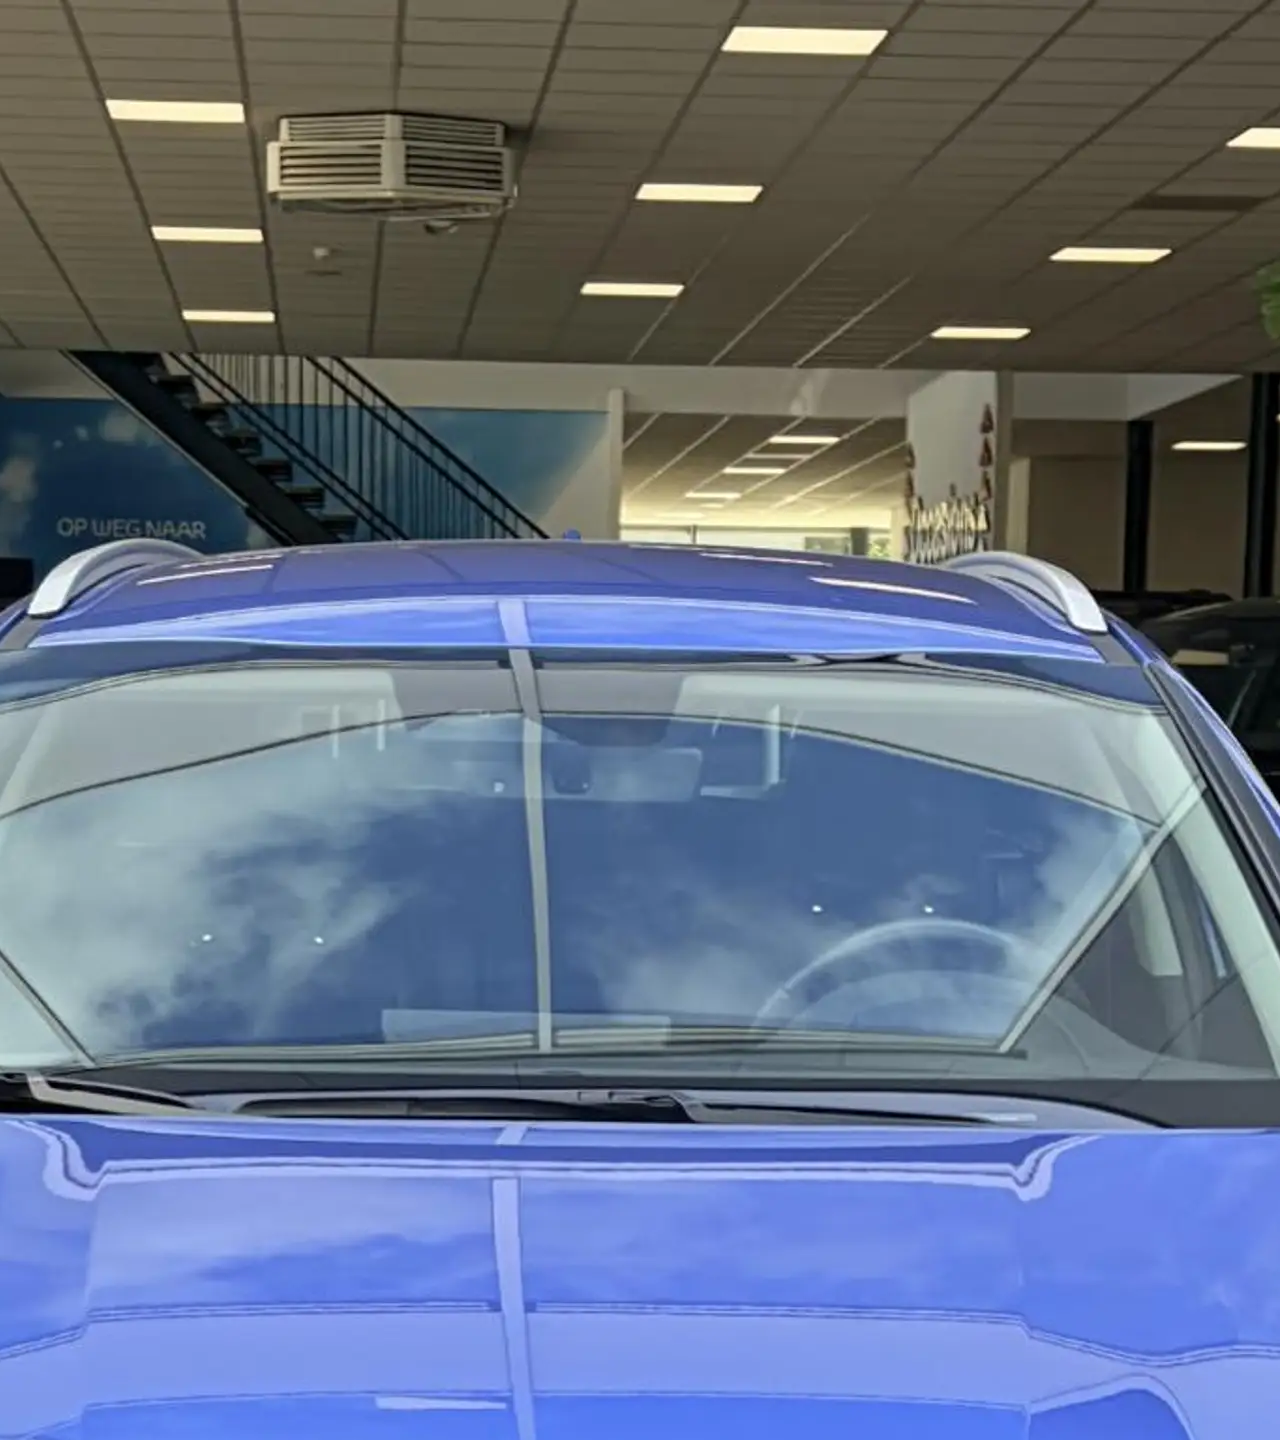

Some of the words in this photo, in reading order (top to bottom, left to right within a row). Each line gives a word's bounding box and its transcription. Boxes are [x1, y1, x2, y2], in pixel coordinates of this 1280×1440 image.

[57, 518, 87, 537] OP
[91, 519, 141, 538] WEG
[145, 521, 207, 539] NAAR
